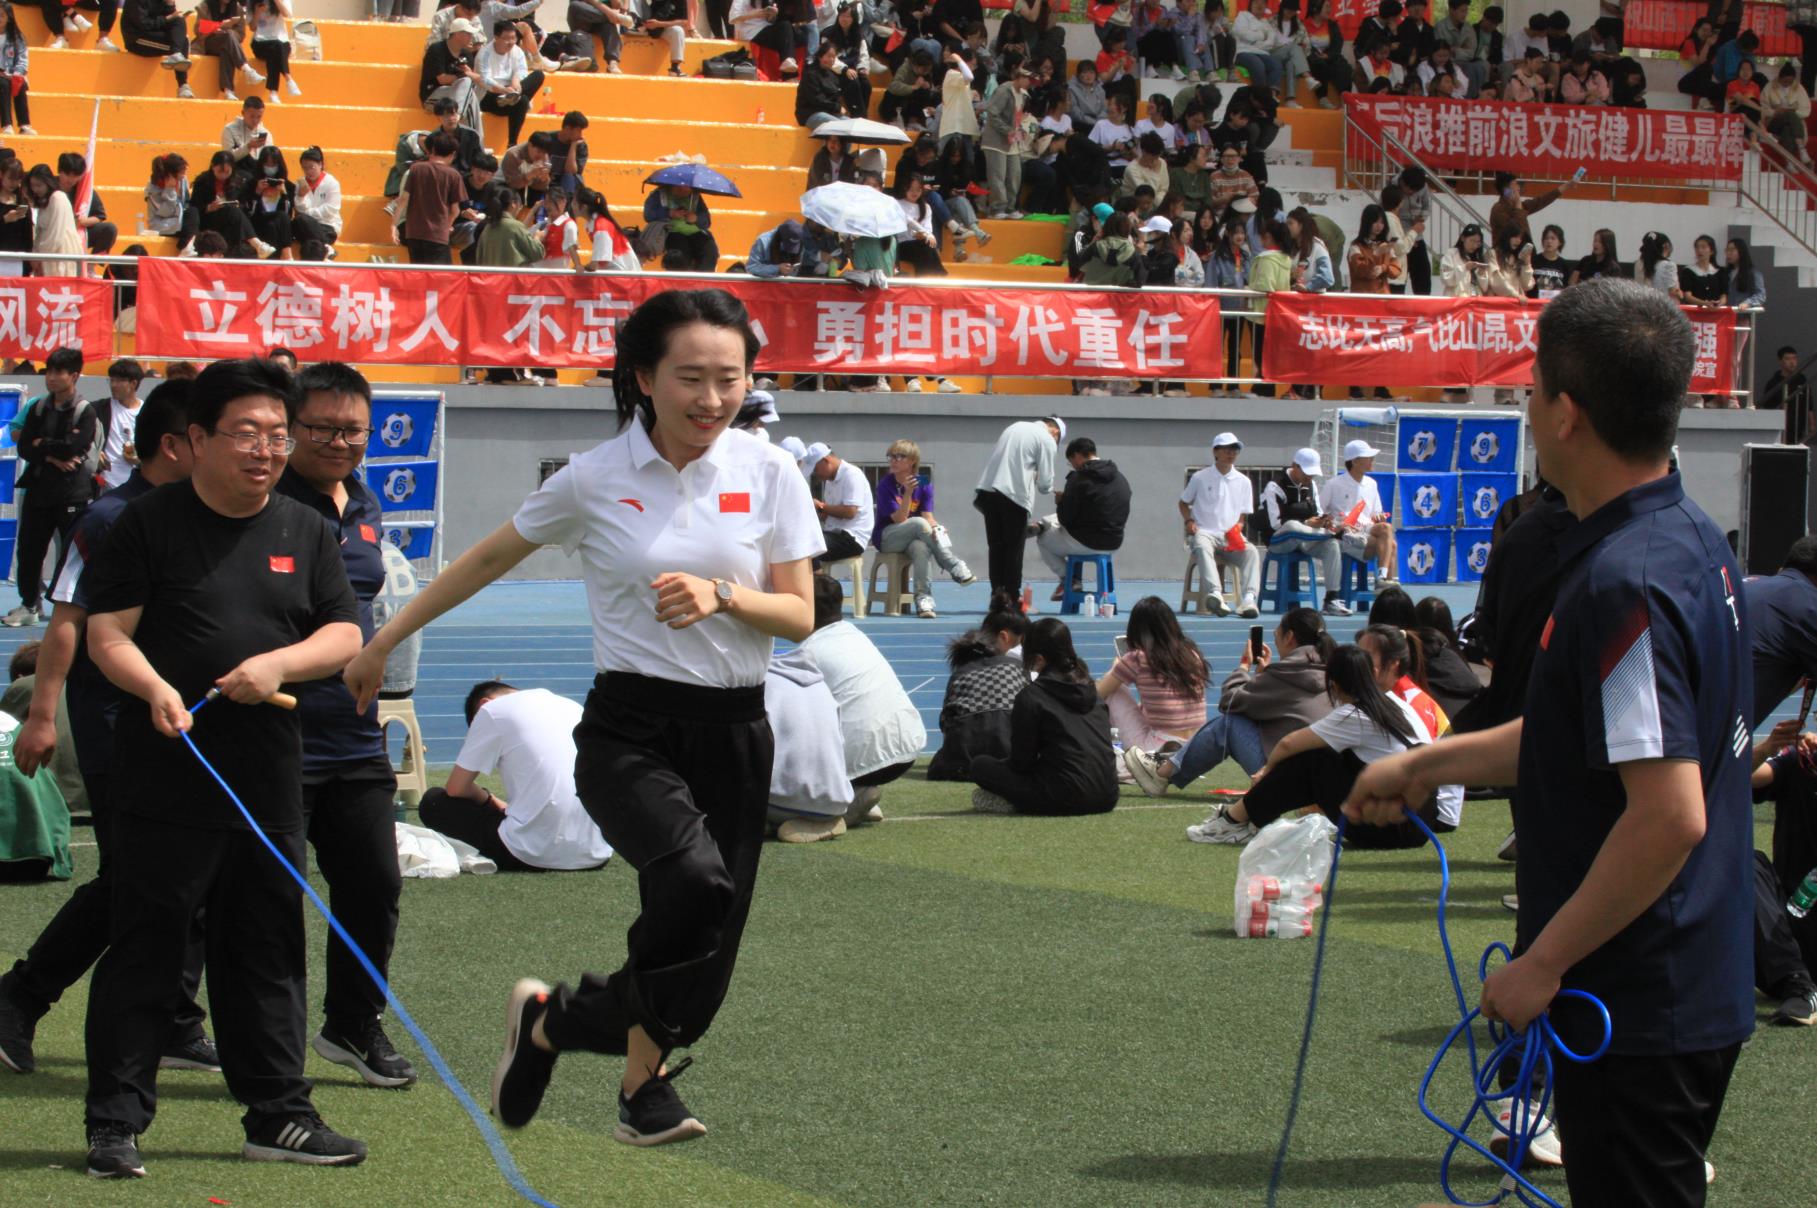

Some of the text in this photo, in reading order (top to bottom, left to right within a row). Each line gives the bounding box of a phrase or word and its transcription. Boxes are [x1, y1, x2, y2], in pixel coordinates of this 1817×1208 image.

[0, 287, 84, 352] 风流
[183, 280, 460, 352] 立德树人
[813, 299, 1189, 368] 勇担时代重任
[390, 420, 404, 441] 9
[1417, 437, 1427, 456] 7
[1479, 438, 1490, 456] 9
[393, 475, 407, 496] 6
[1421, 492, 1432, 511] 4
[1480, 494, 1490, 512] 6
[1417, 549, 1425, 568] 1
[1475, 547, 1486, 567] 3
